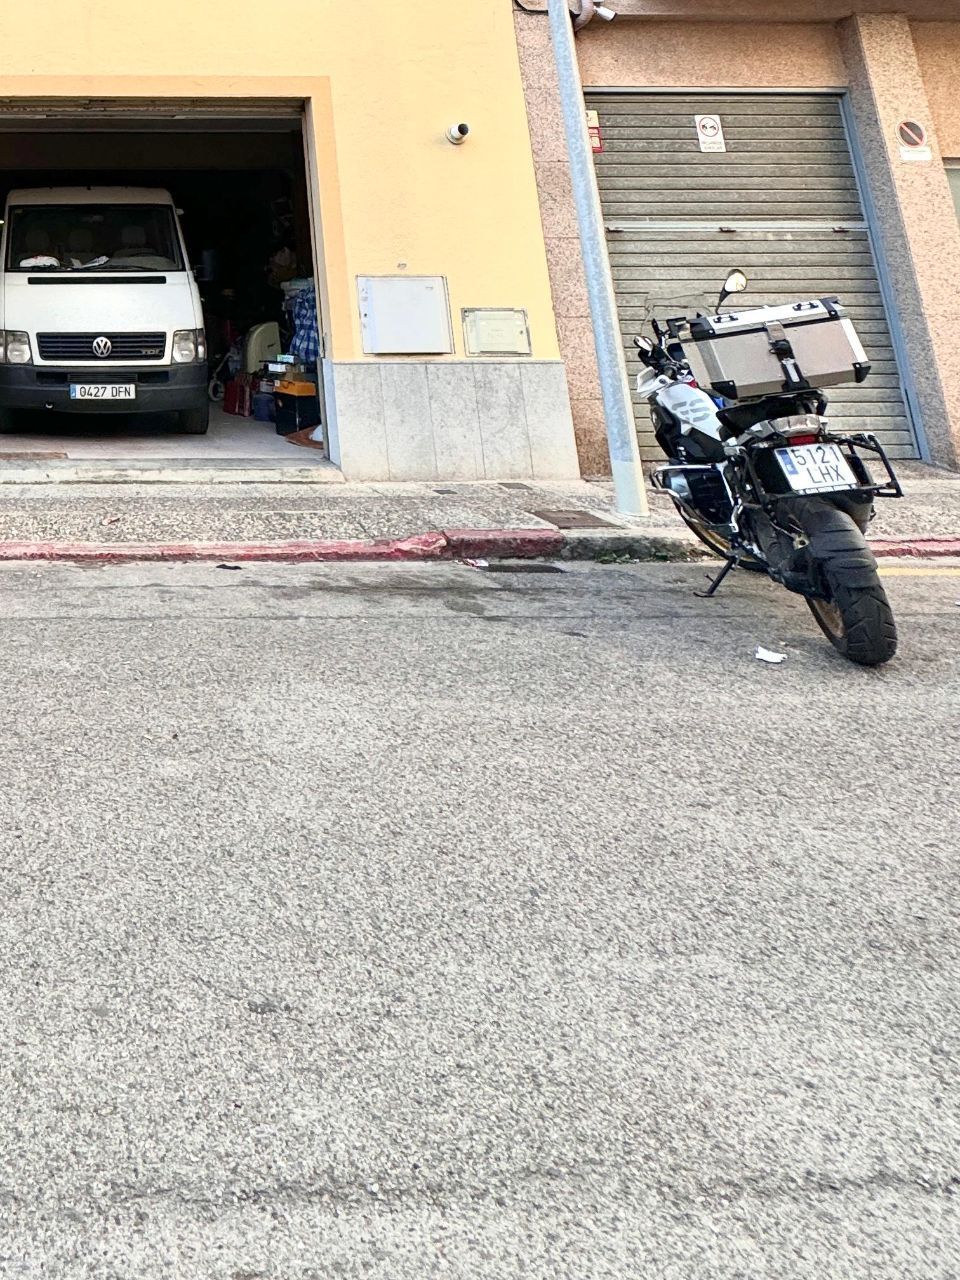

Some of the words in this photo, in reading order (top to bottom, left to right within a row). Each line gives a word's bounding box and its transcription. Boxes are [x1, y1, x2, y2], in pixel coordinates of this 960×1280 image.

[79, 386, 107, 398] 0427
[111, 386, 131, 398] DFN
[790, 445, 840, 466] 5121
[806, 464, 846, 484] LHX
